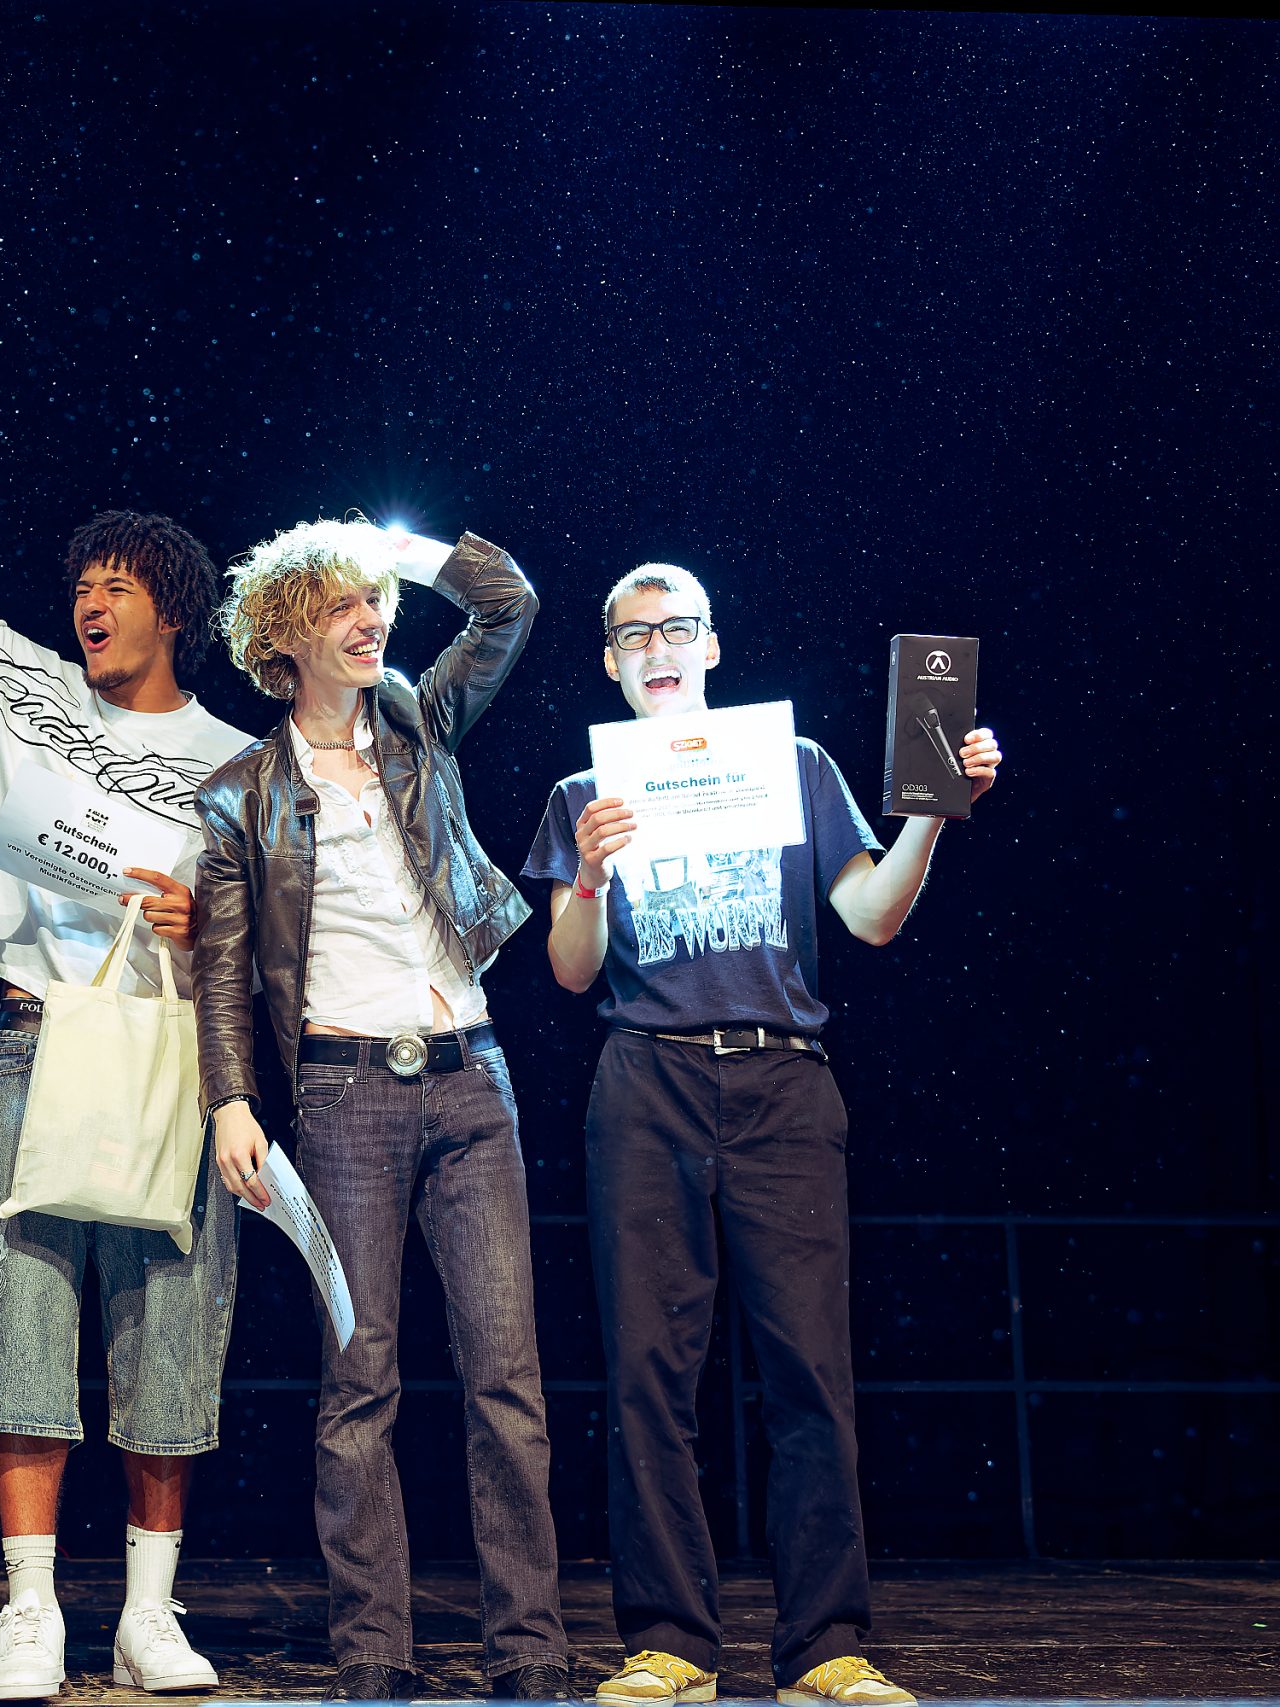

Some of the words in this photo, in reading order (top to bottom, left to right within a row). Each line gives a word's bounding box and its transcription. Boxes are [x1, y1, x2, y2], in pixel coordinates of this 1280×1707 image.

[645, 774, 721, 792] Gutschein
[902, 784, 928, 792] OD303
[53, 819, 118, 856] Gutschein
[7, 842, 22, 855] von
[25, 850, 68, 876] Vereinigte
[37, 833, 49, 846] €
[54, 840, 118, 880] 12.000,-
[39, 867, 99, 896] Musikförderer
